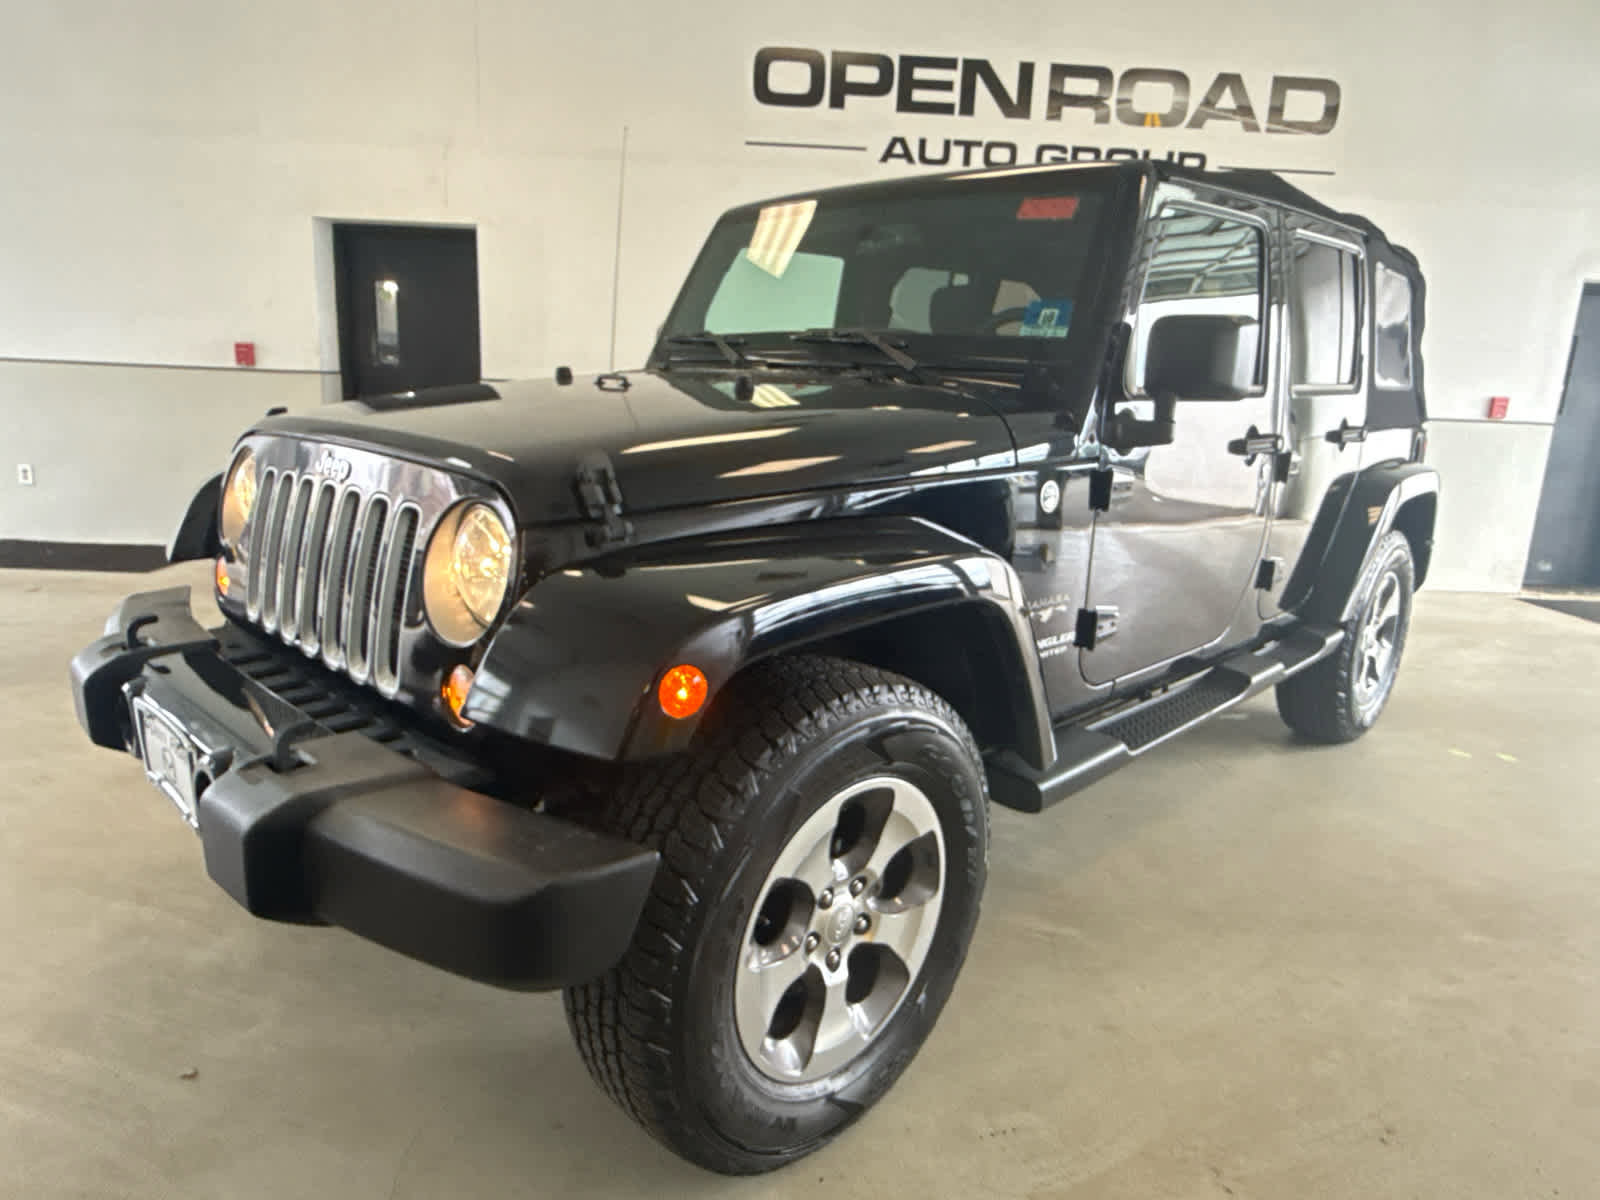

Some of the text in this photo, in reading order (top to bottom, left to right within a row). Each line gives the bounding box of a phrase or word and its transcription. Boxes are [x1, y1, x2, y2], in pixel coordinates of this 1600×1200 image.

[753, 46, 1341, 135] OPEN ROAD
[879, 136, 1017, 168] AUTO
[315, 449, 352, 483] Jeep
